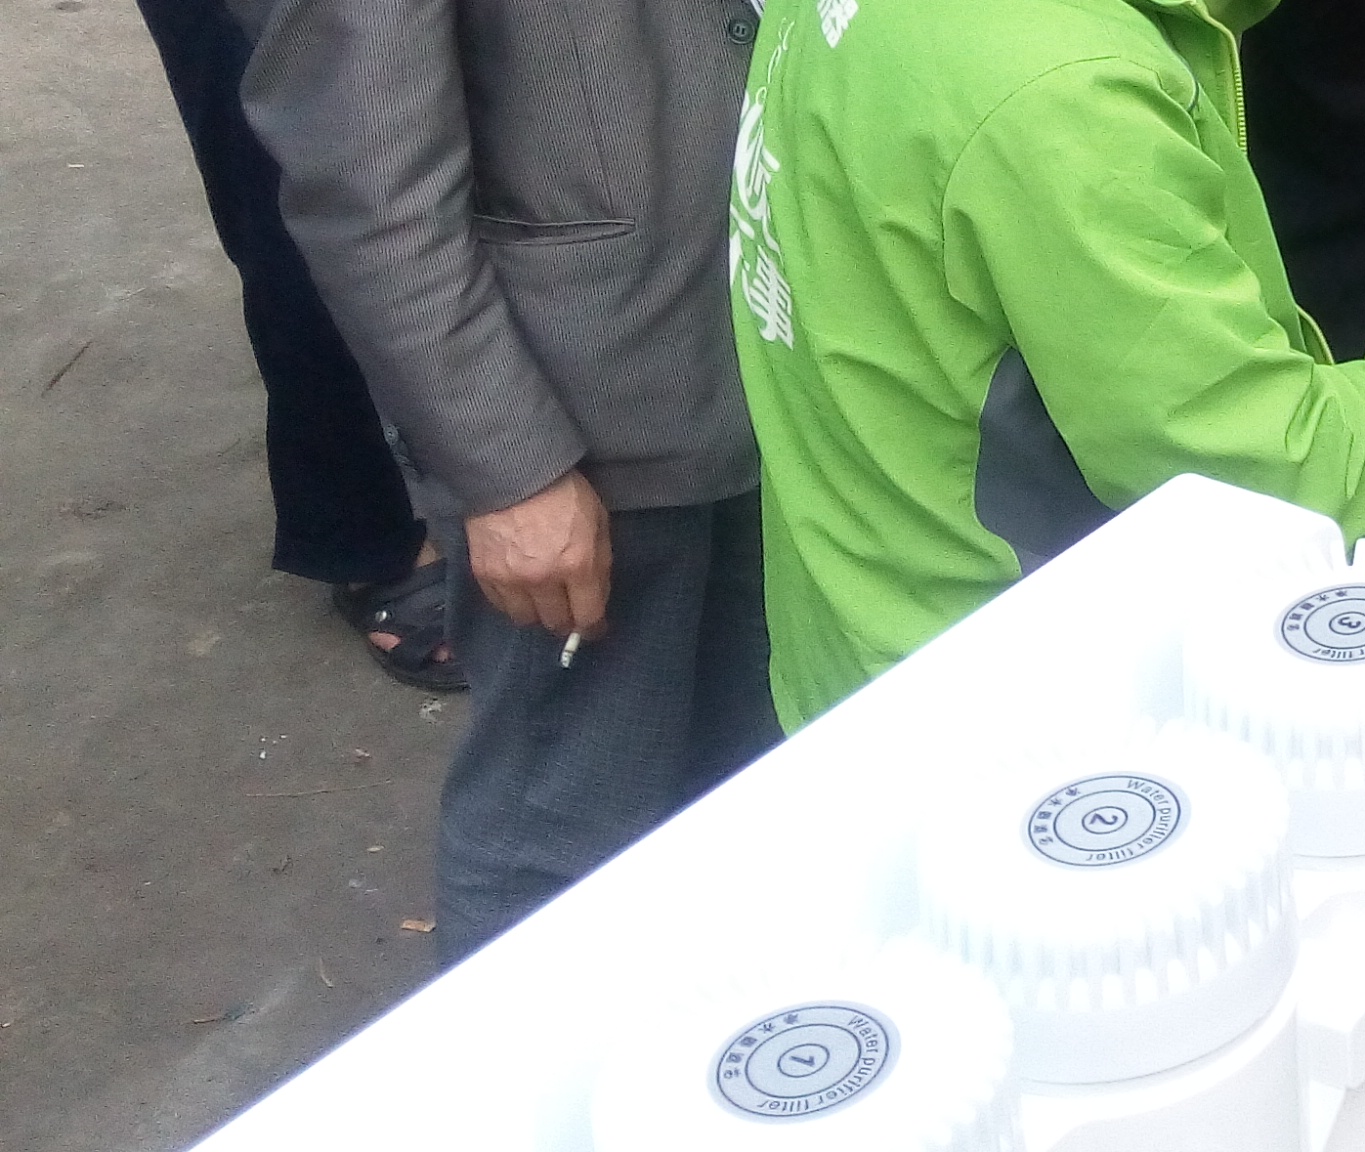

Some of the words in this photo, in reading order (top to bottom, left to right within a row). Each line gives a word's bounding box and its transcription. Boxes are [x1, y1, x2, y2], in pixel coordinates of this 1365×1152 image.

[1337, 615, 1361, 630] 3
[1126, 779, 1169, 805] Water
[1089, 812, 1119, 826] 2
[847, 1014, 879, 1054] Water
[789, 1055, 816, 1067] 1
